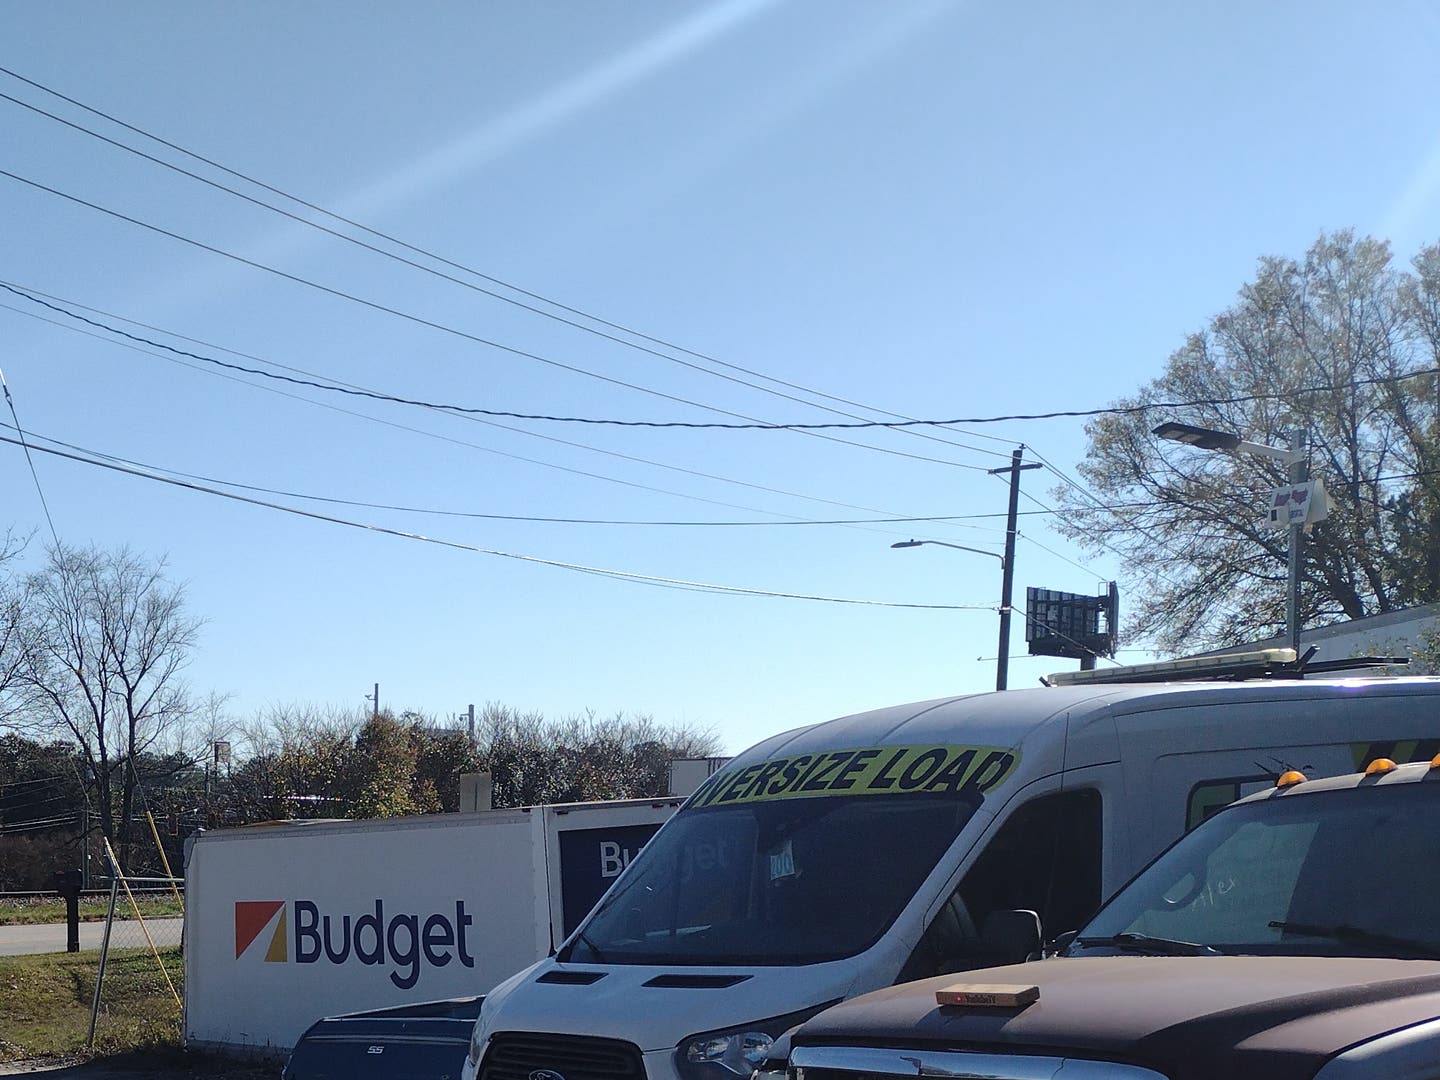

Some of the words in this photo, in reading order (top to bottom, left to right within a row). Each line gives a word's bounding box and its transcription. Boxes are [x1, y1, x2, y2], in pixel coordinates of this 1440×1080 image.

[868, 748, 1015, 793] LOAD
[294, 899, 475, 990] Budget
[367, 1045, 385, 1054] SS
